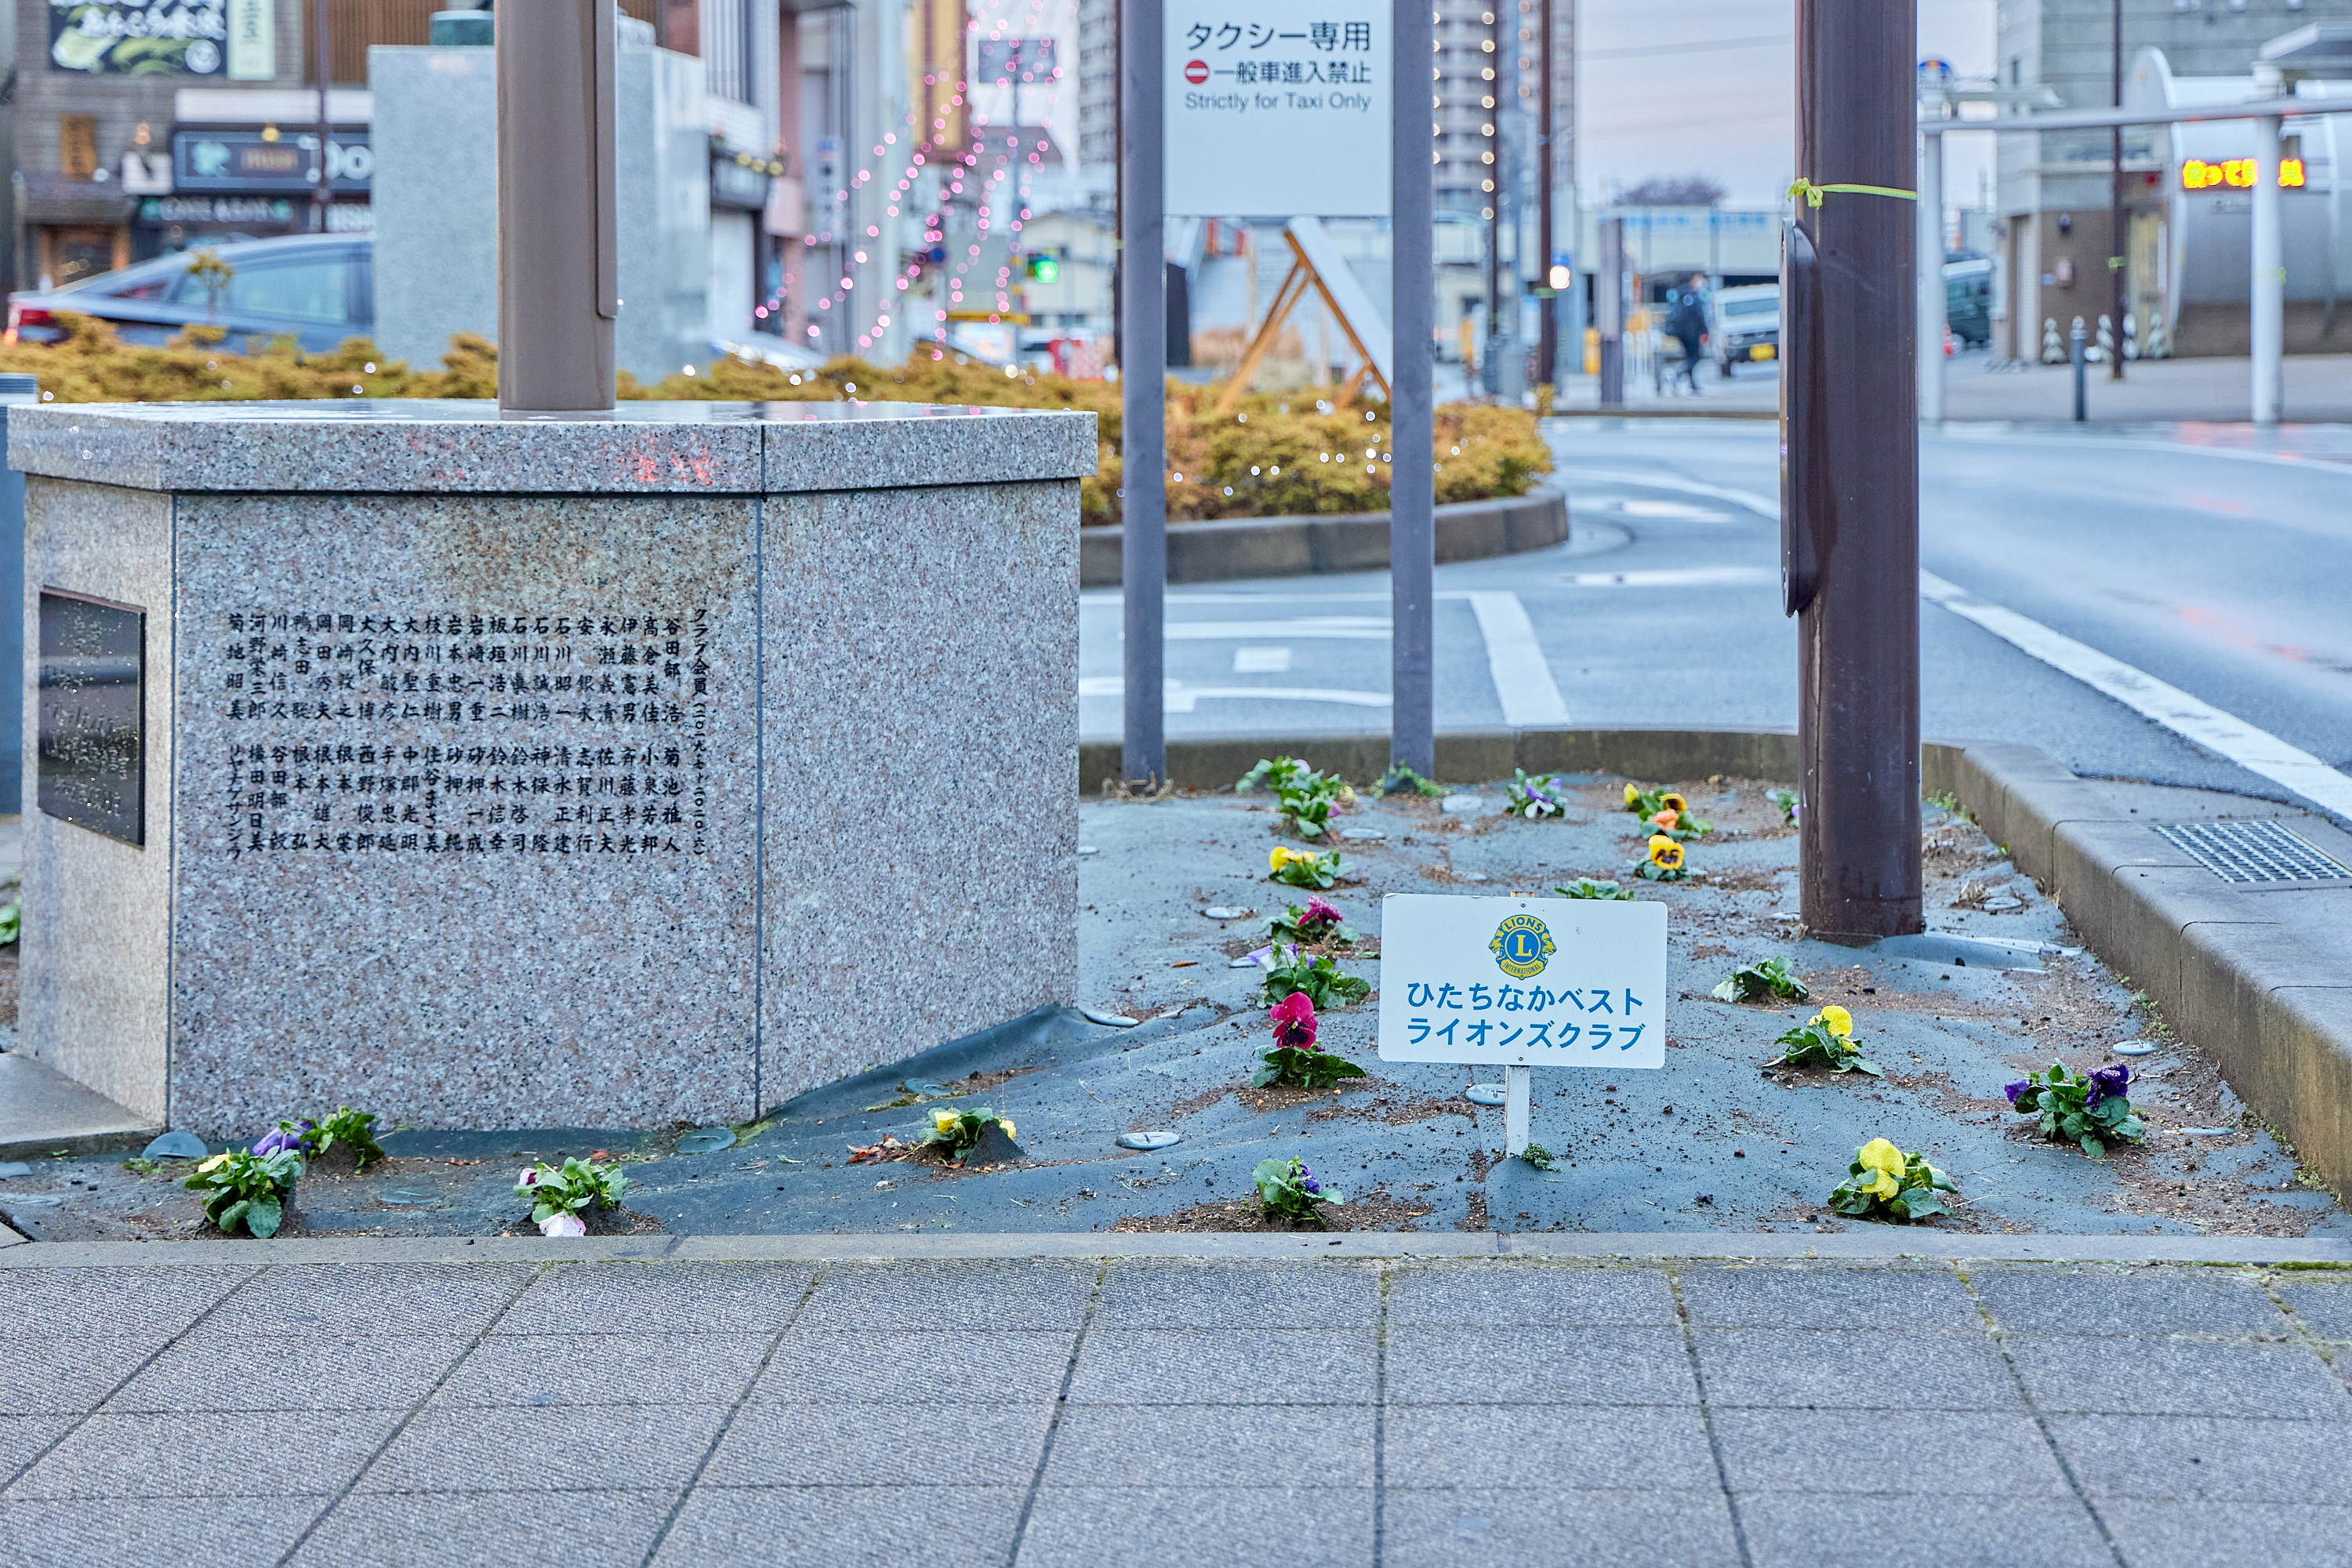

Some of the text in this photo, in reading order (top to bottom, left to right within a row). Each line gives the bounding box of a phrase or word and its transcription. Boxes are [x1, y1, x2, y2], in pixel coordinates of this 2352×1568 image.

[1186, 20, 1371, 51] タクシー専用
[1214, 60, 1372, 84] 一般車進入禁止
[1185, 92, 1372, 113] Strictly for Taxi Only
[1504, 916, 1543, 931] LIONS
[1515, 935, 1533, 957] L
[1503, 962, 1541, 975] INTERNATIONAL
[1406, 982, 1643, 1016] ひたちなかベスト
[1406, 1018, 1646, 1051] ライオンズクラブ
